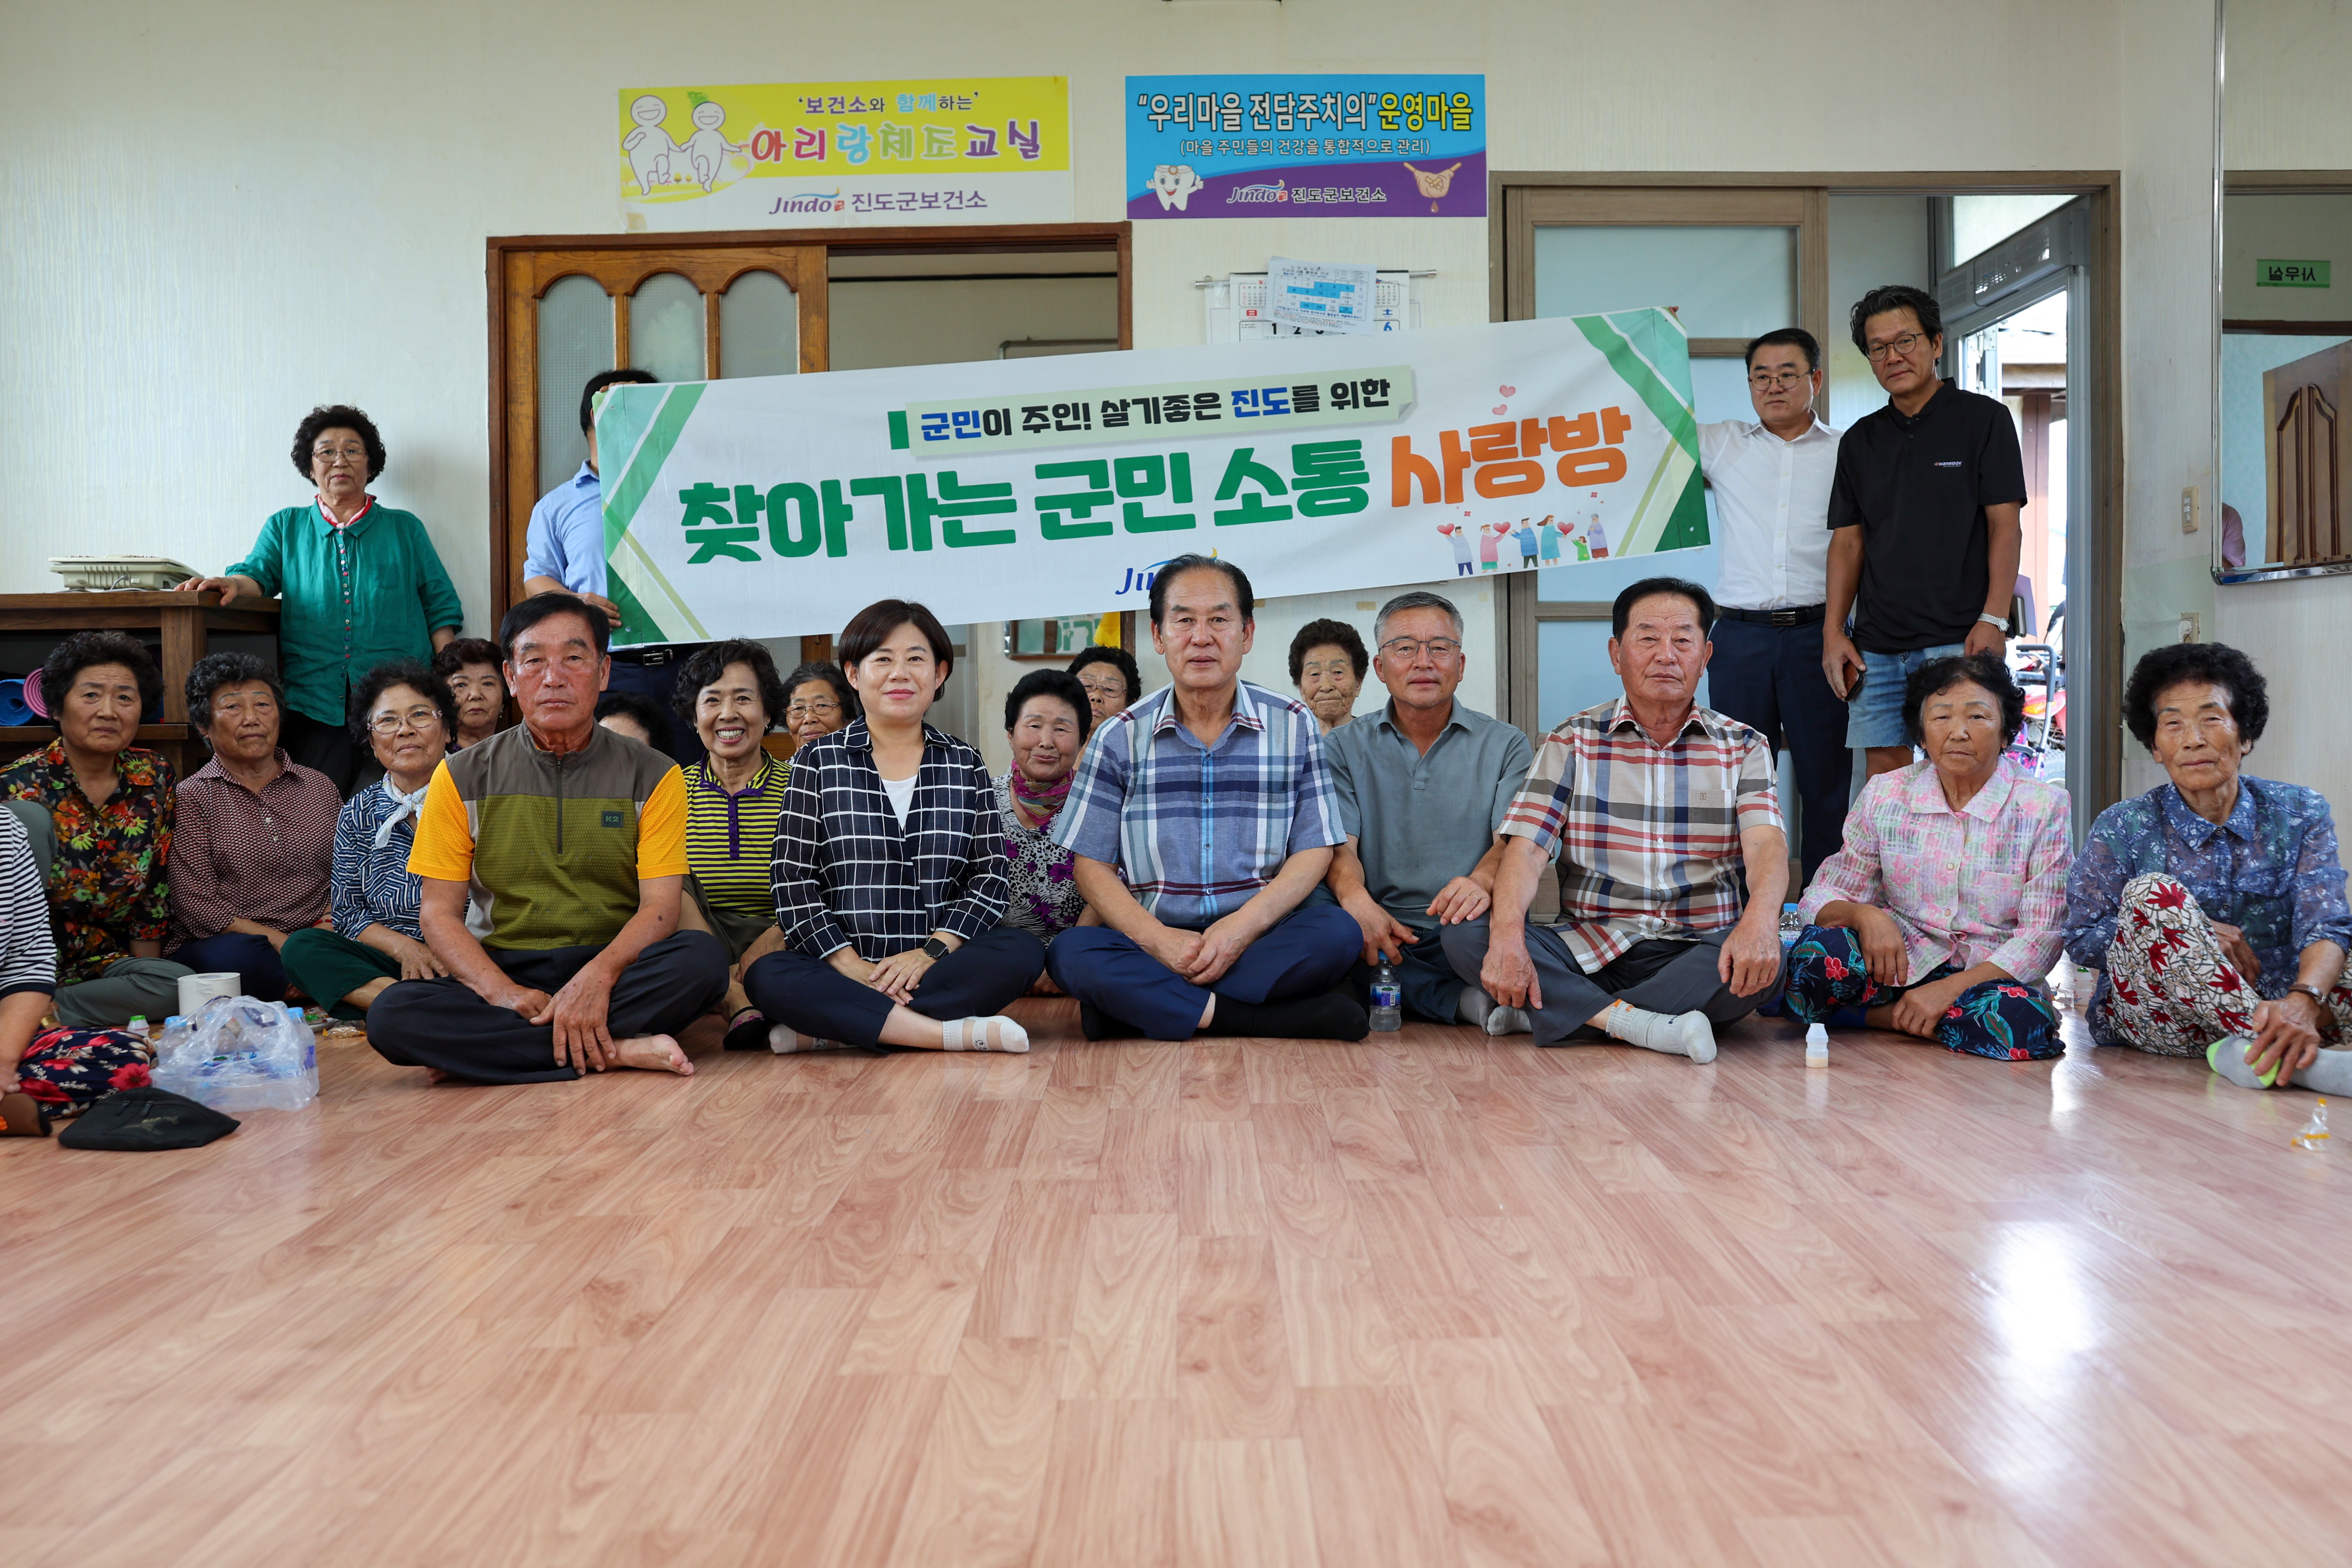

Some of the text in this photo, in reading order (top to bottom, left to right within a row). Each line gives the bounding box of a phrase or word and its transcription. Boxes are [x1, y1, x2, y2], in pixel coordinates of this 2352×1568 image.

[1180, 138, 1430, 156] (마을 주민들의 건강을 통합적으로 관리)
[851, 189, 988, 212] 진도군보건소
[1227, 187, 1278, 203] Jindo
[1292, 187, 1387, 203] 진도군보건소
[769, 196, 832, 214] Jindo
[1272, 323, 1277, 334] 1
[1384, 321, 1392, 331] 6
[920, 378, 1390, 441] 군민이 주인! 살기좋은 진도를 위한
[679, 406, 1631, 564] 찾아가는 군민 소통 사랑방
